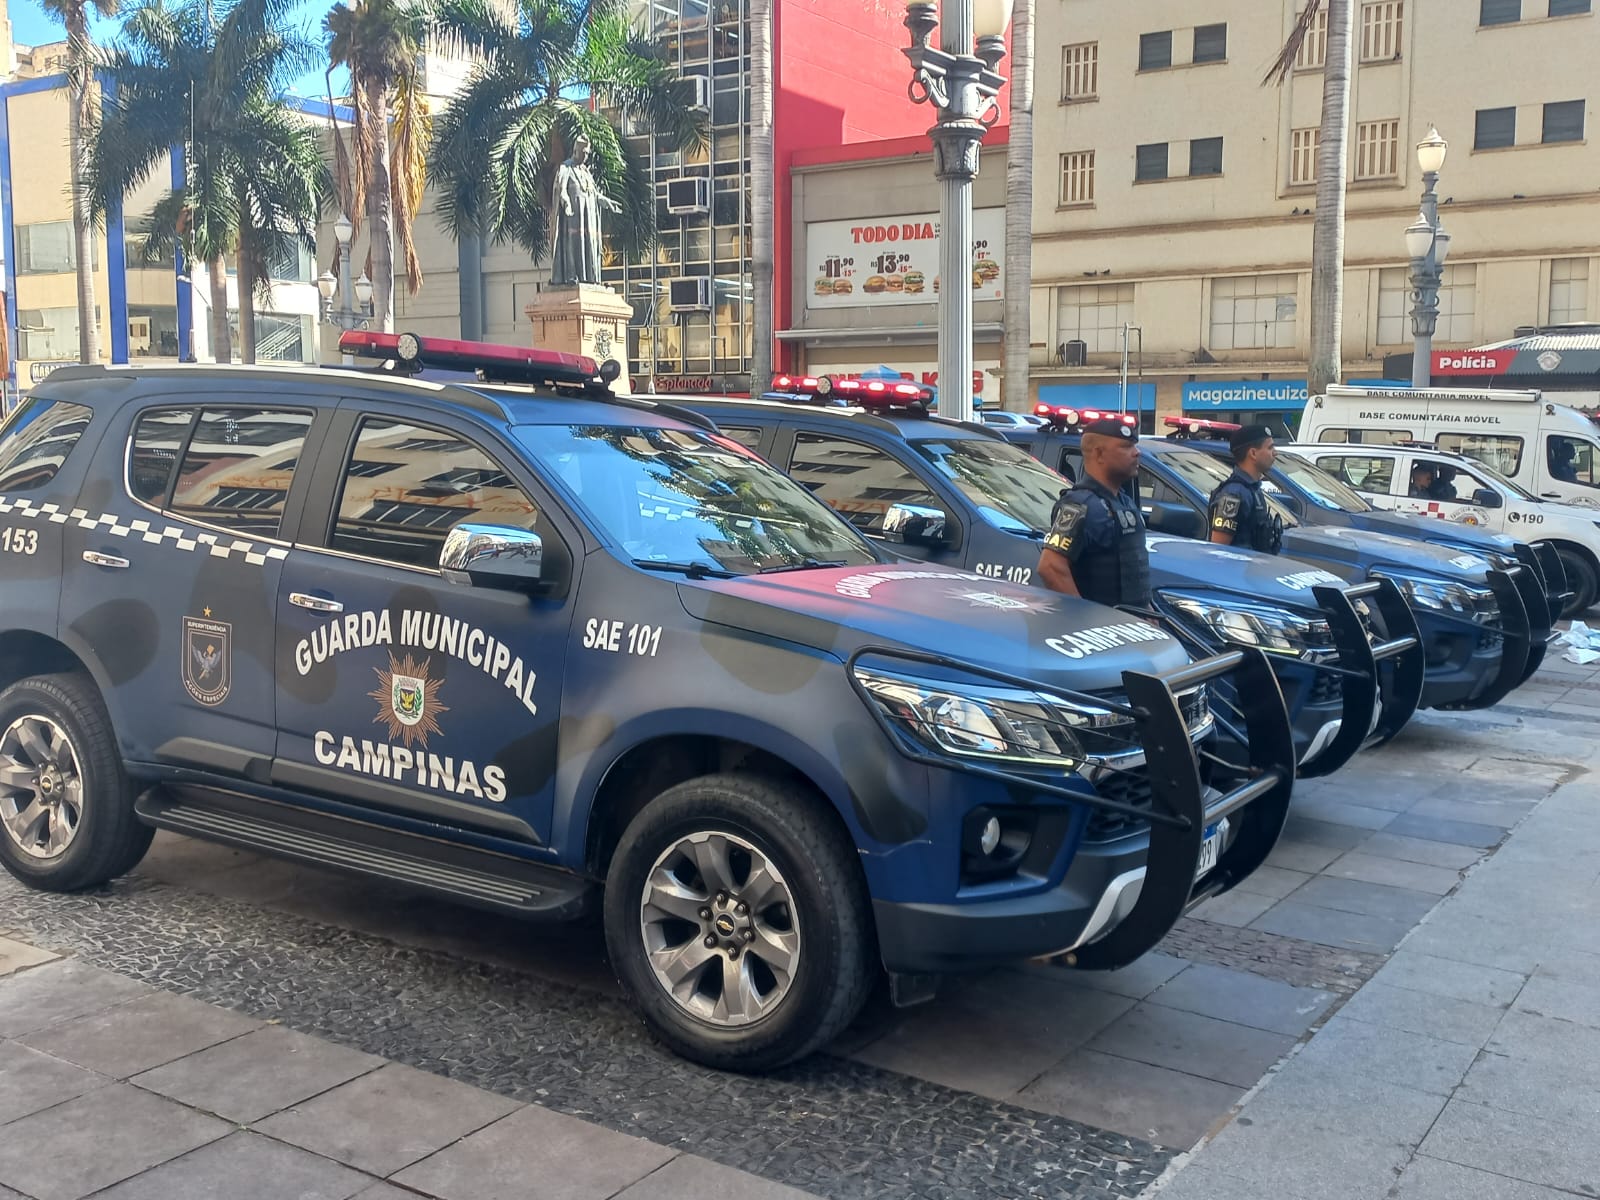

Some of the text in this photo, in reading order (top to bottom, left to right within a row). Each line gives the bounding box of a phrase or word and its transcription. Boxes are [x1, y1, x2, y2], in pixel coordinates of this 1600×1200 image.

[851, 225, 900, 244] TODO
[902, 222, 935, 240] DIA
[1439, 356, 1496, 369] Polícia
[1359, 411, 1501, 424] BASE COMUNITÁRIA MÓVEL
[1522, 513, 1544, 524] 190
[1, 527, 39, 555] 153
[1006, 566, 1032, 586] 102
[583, 617, 663, 656] SAE 101
[1044, 621, 1170, 659] CAMPINAS
[295, 608, 538, 716] GUARDA MUNICIPAL
[314, 730, 507, 802] CAMPINAS
